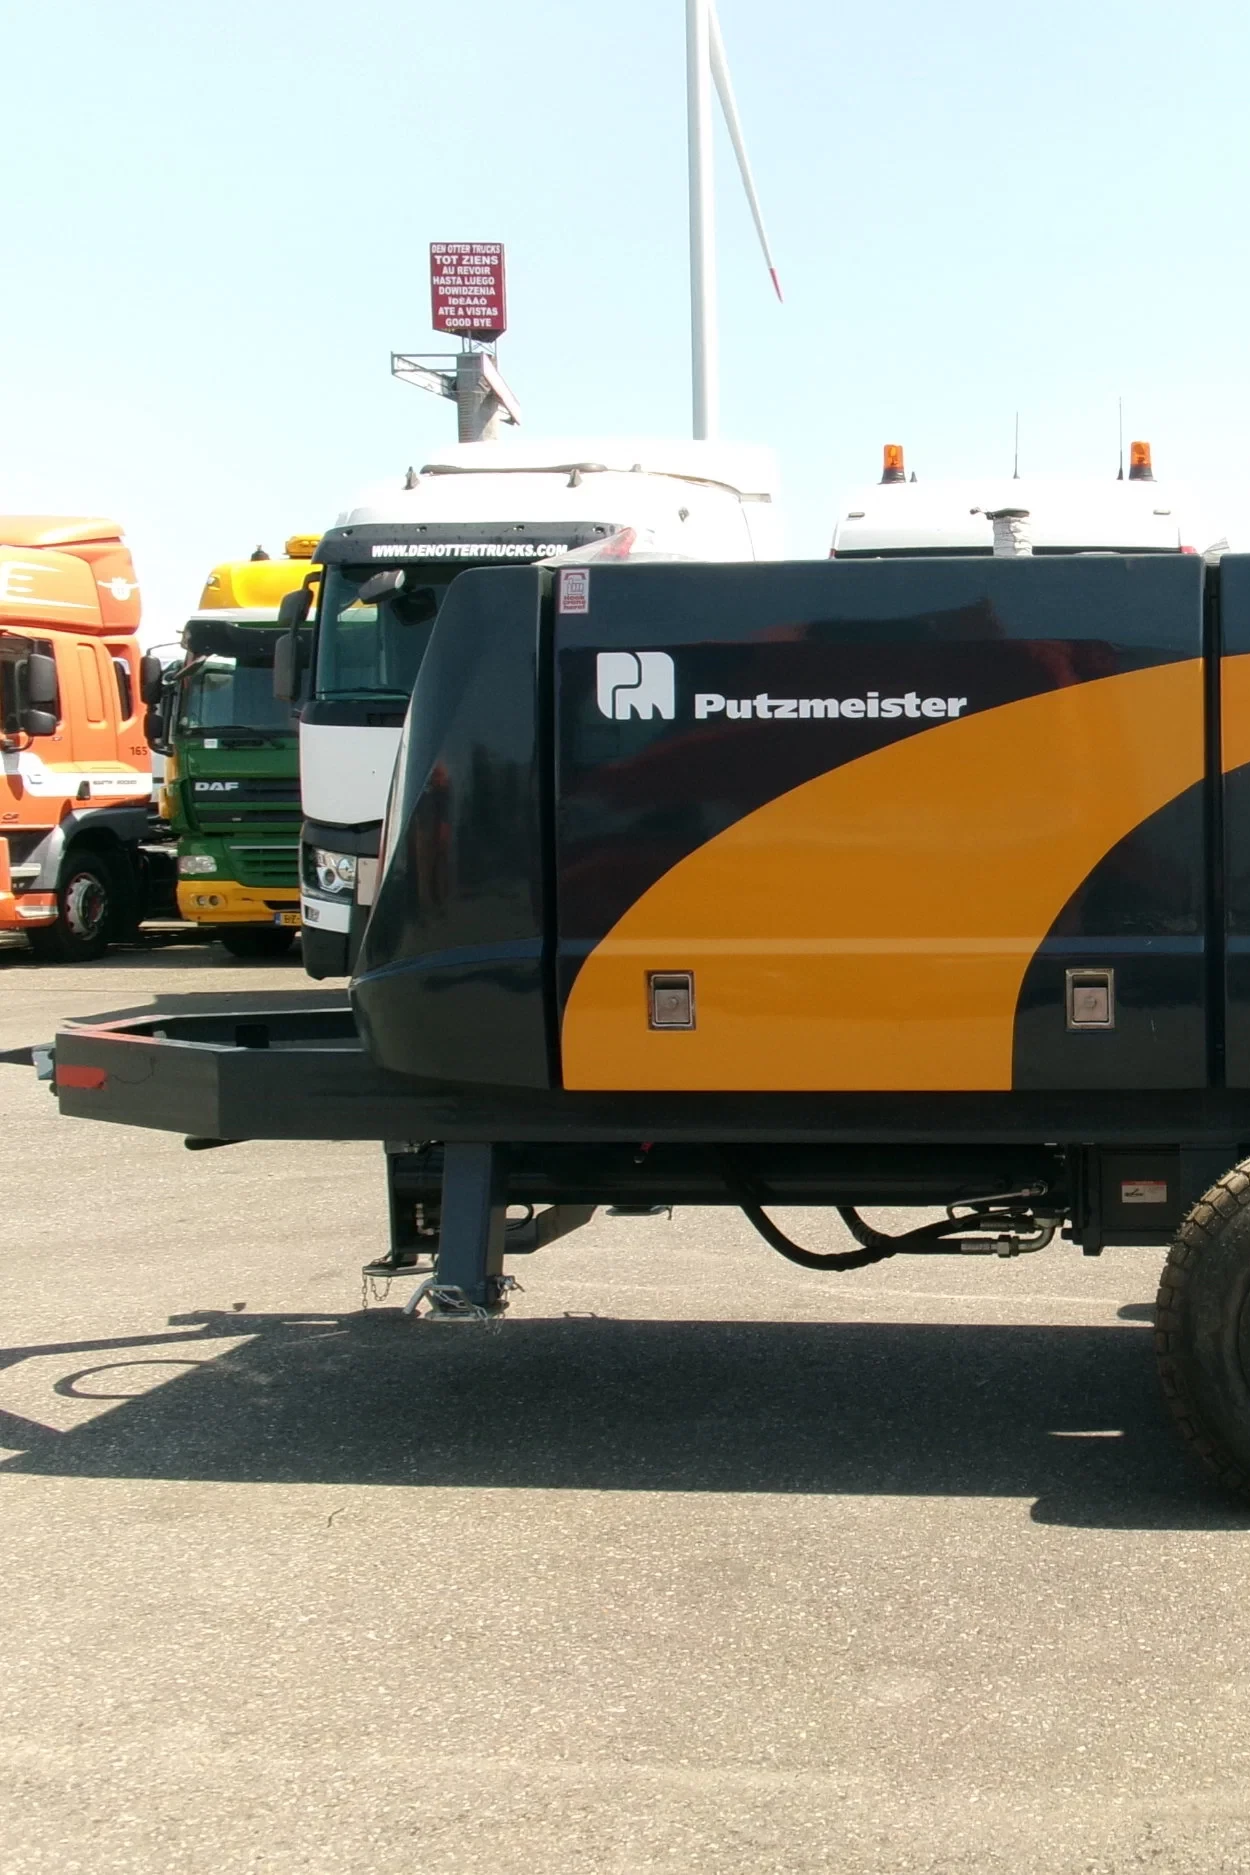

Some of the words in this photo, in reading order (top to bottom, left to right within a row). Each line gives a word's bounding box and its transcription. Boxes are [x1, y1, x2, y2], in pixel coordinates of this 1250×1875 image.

[431, 244, 447, 254] DEN
[447, 244, 471, 254] OTTER
[472, 244, 501, 254] TRUCKS
[434, 255, 459, 265] TOT
[462, 255, 499, 265] ZIENS
[442, 266, 455, 275] AU
[457, 266, 491, 275] REVOIR
[432, 276, 463, 285] HASTA
[464, 276, 495, 285] LUEGO
[438, 286, 496, 295] DOWIDZENIA
[438, 307, 456, 316] ATE
[457, 307, 465, 316] A
[466, 307, 498, 316] VISTAS
[445, 318, 472, 327] GOOD
[473, 318, 492, 327] BYE
[371, 544, 569, 558] WWW.DENOTTERTRUCKS.COM
[694, 691, 968, 719] Putzmeister
[129, 746, 148, 756] 165
[194, 781, 239, 791] DAF
